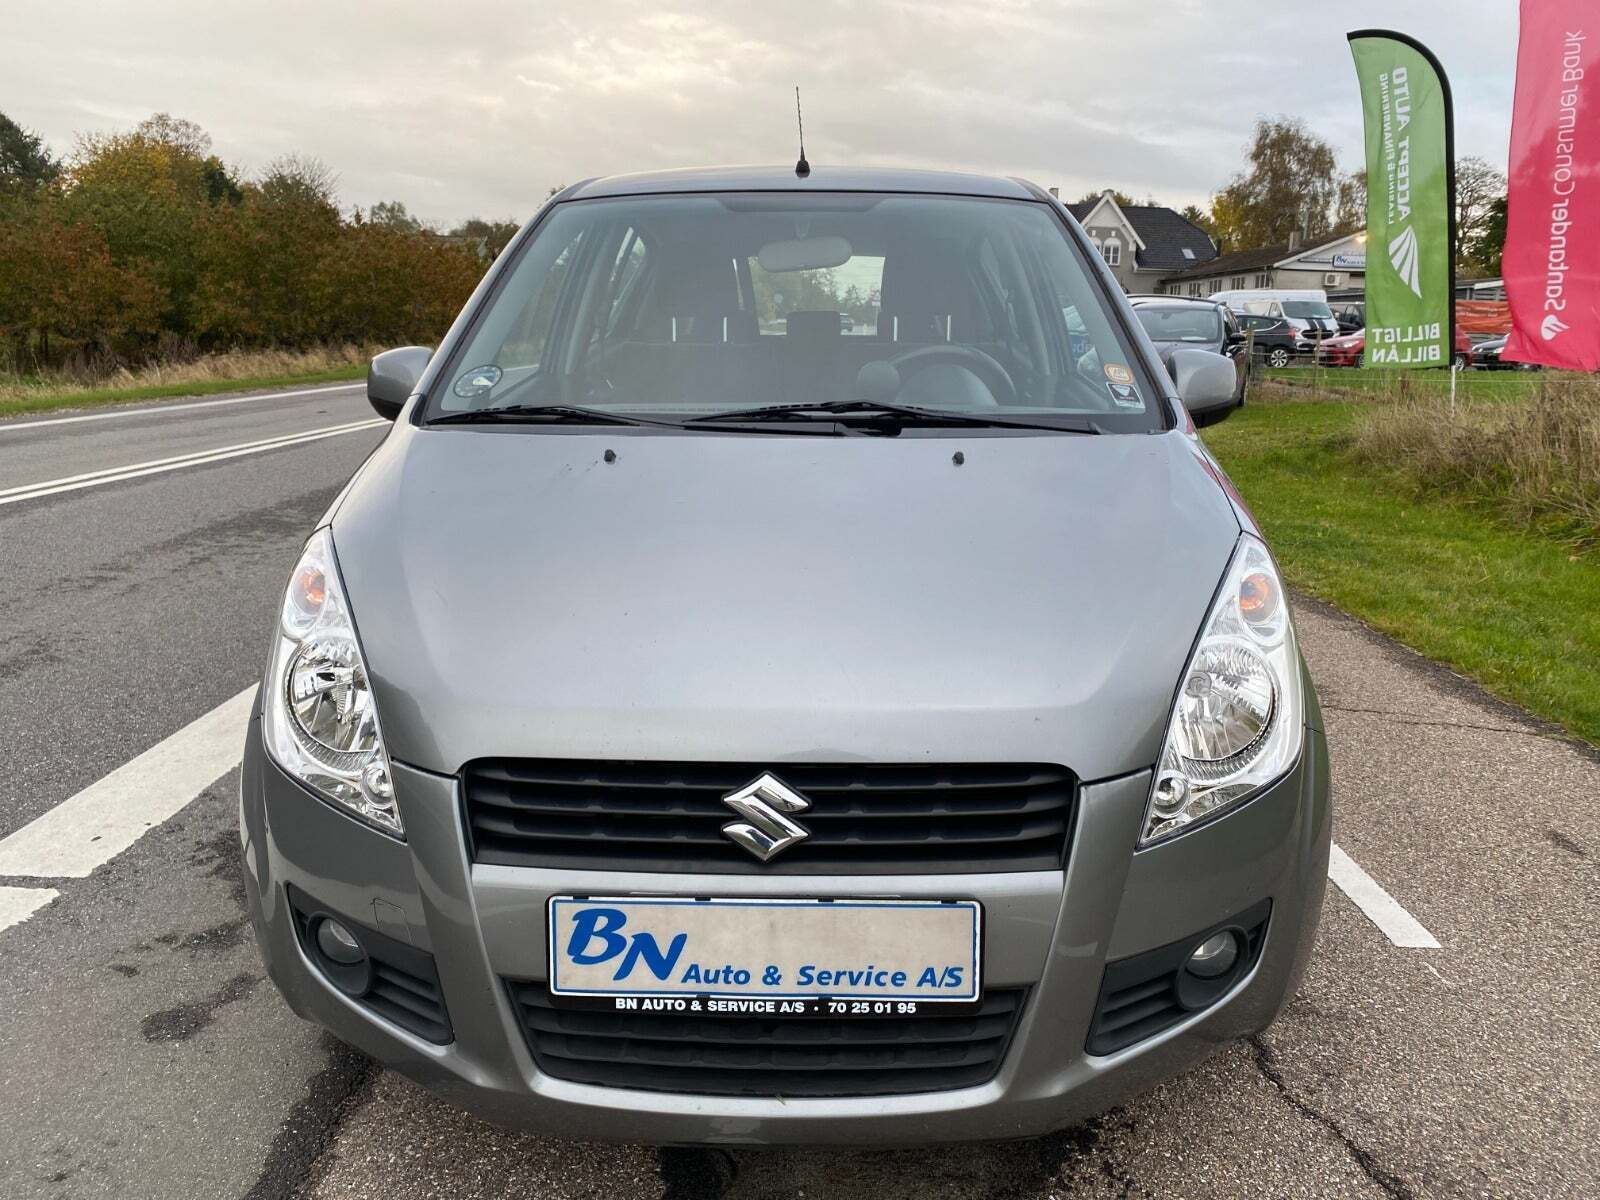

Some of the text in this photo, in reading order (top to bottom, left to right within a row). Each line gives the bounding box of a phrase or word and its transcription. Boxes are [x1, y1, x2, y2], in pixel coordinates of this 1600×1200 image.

[566, 908, 964, 988] BN Auto & Service A/S
[615, 998, 916, 1014] BN AUTO & SERVICE A/S 70 25 01 95
